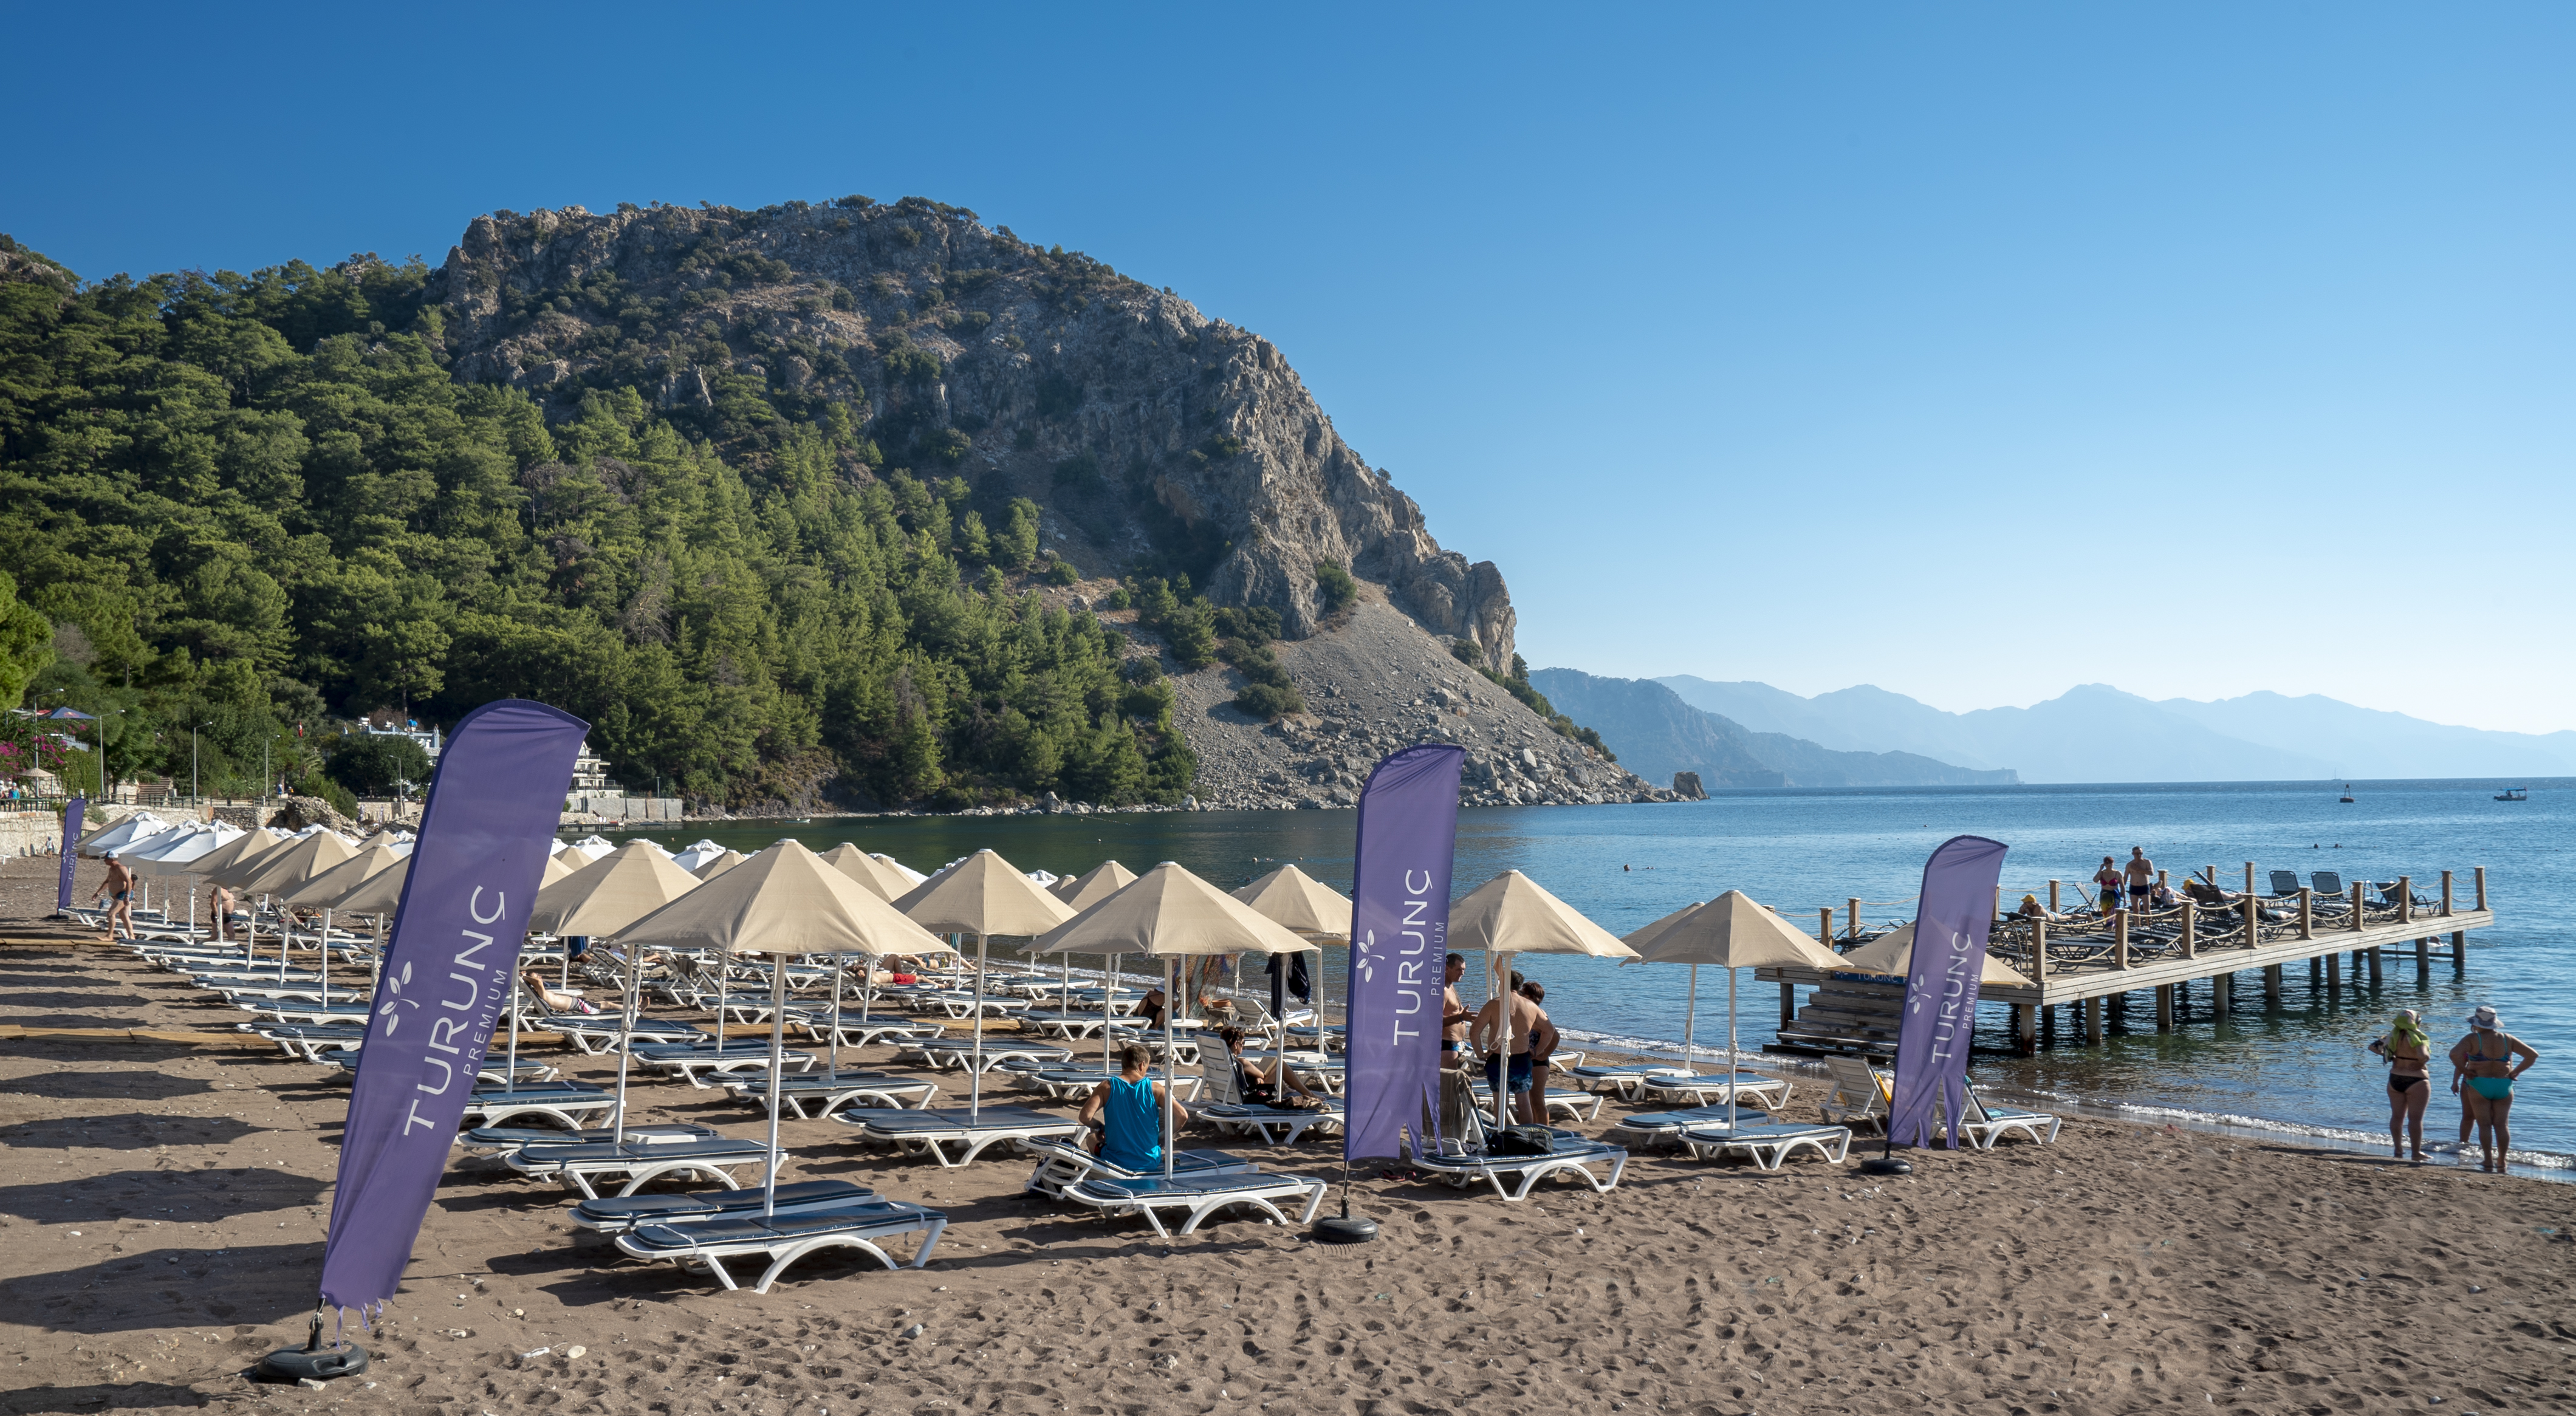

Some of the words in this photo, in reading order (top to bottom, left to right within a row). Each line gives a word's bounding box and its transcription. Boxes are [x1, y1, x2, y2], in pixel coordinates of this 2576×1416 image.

[403, 885, 505, 1136] TURUNÇ
[1393, 869, 1433, 1045] TURUNÇ
[1431, 922, 1444, 996] PREMIUM
[1931, 932, 1972, 1064] TURUNÇ
[1962, 974, 1979, 1030] PREMIUM
[463, 970, 507, 1076] PREMIUM
